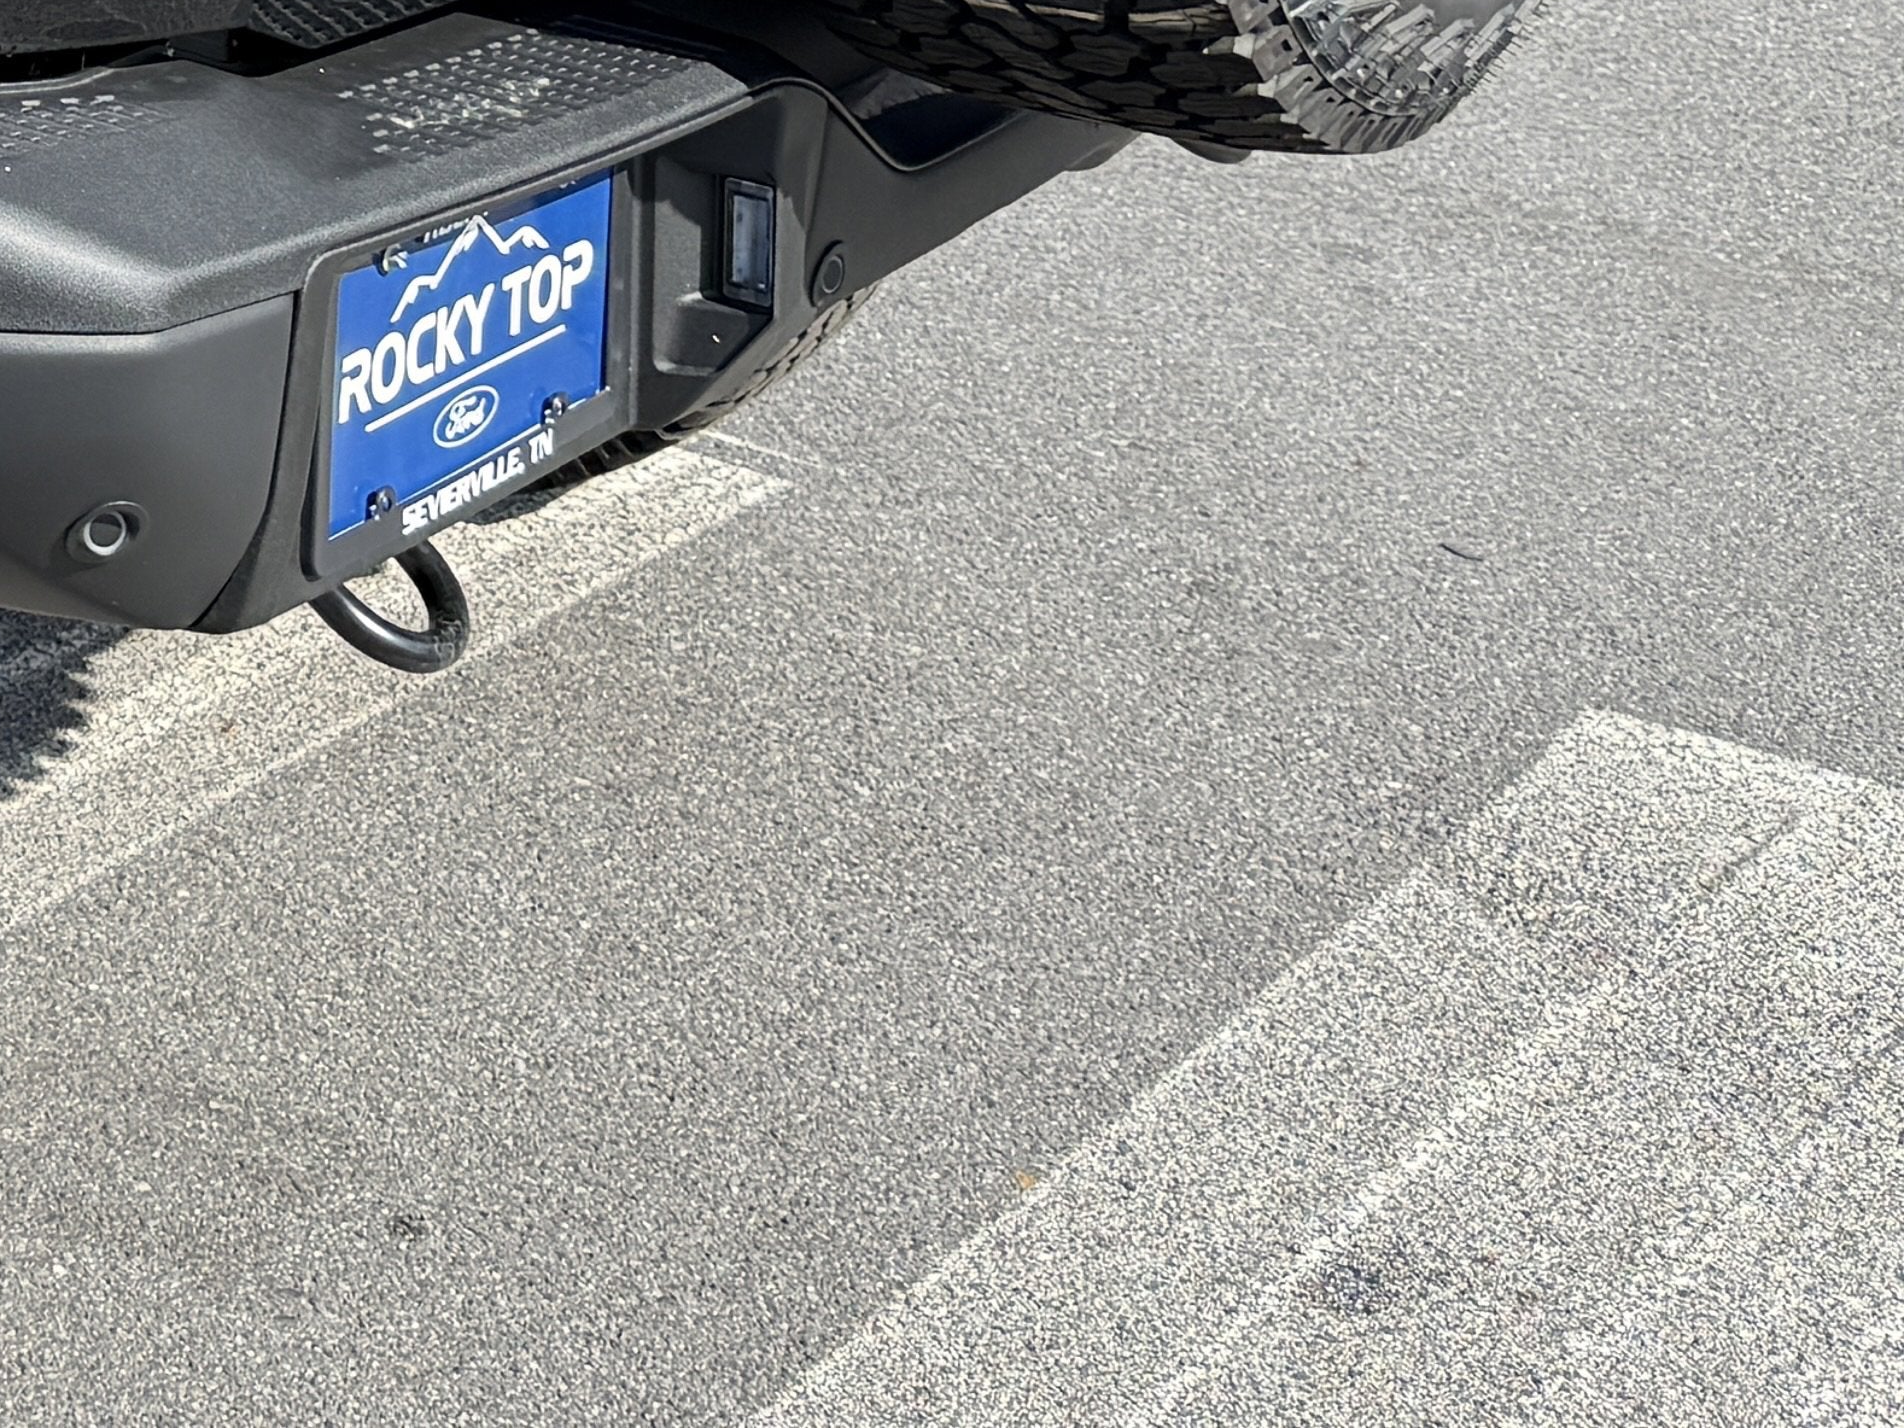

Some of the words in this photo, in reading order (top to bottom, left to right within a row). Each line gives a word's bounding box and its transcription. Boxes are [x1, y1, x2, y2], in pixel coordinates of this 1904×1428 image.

[338, 282, 495, 424] ROCKY
[501, 239, 594, 337] TOP
[444, 394, 487, 441] Ford
[401, 446, 525, 536] SEVIERVILLE,
[529, 427, 555, 465] TN
